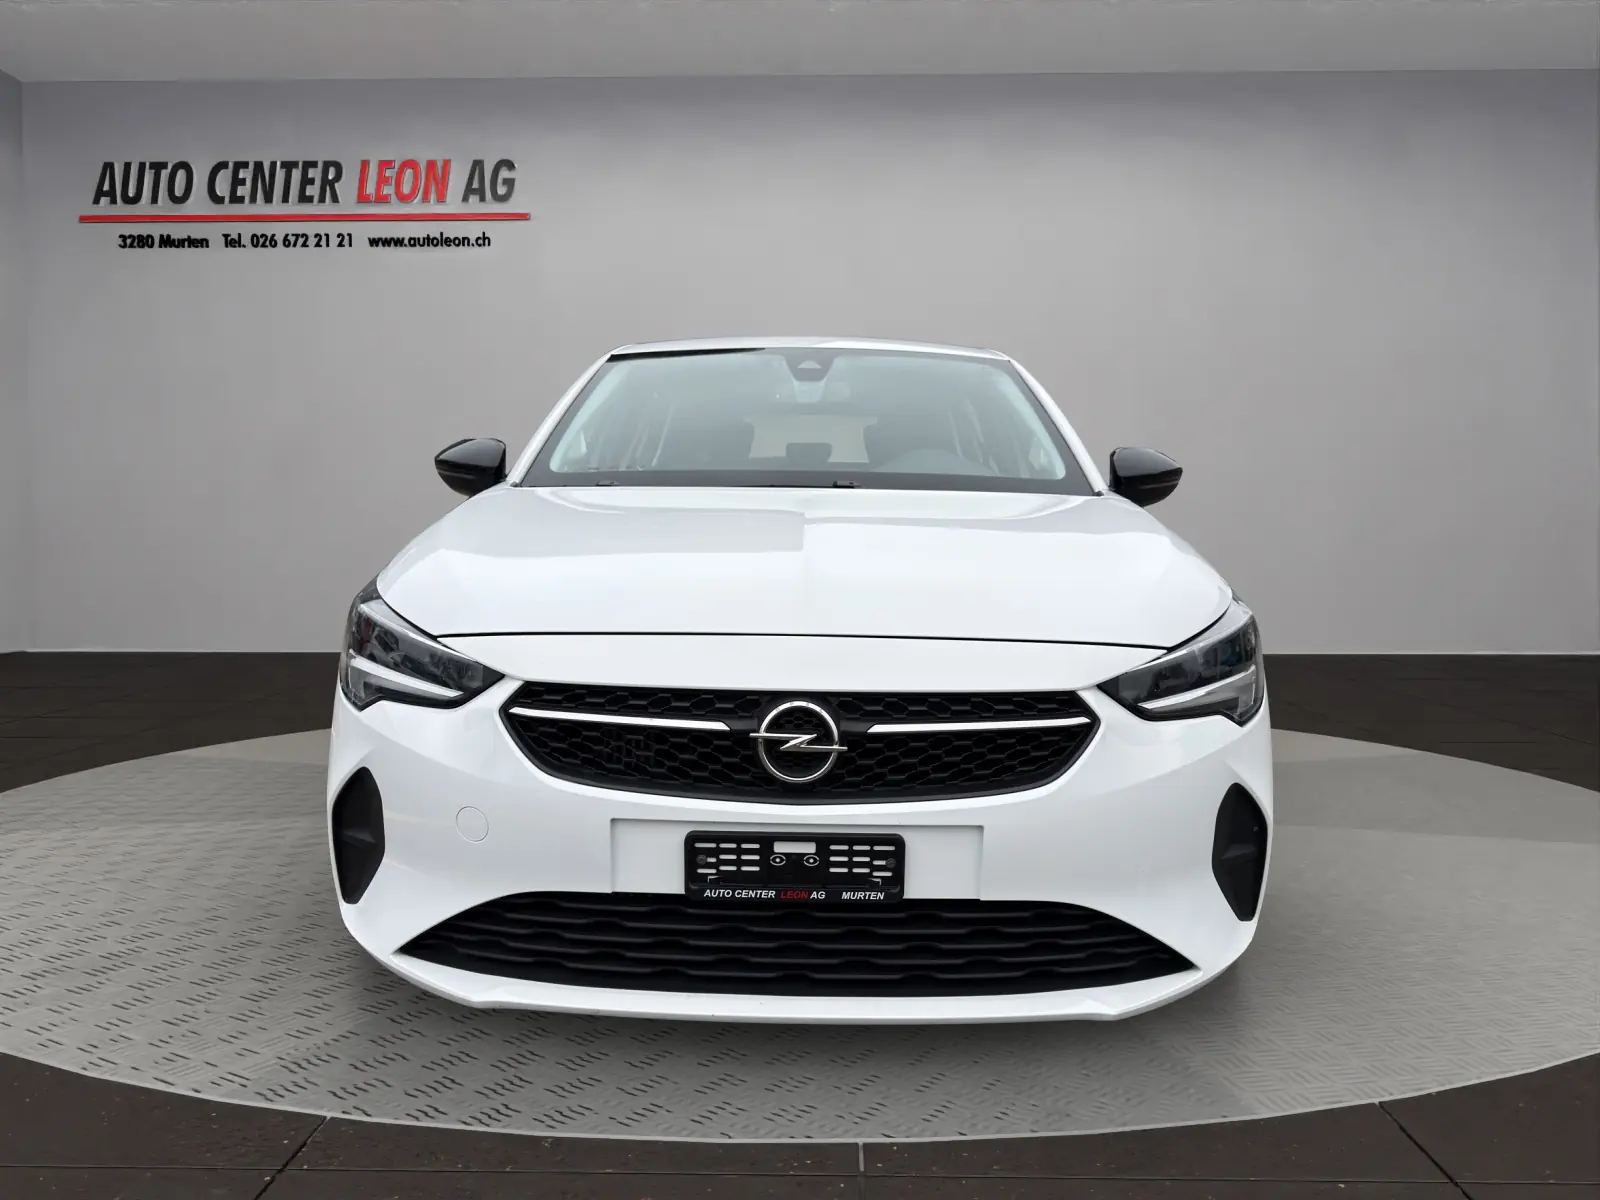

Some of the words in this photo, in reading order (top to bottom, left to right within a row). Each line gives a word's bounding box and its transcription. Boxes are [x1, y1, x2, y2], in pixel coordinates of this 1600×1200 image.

[92, 160, 194, 206] AUTO
[206, 159, 344, 206] CENTER
[356, 158, 452, 204] LEON
[461, 158, 516, 204] AG
[118, 234, 155, 249] 3280
[158, 234, 210, 249] Murten
[222, 233, 247, 248] Tel.
[250, 233, 279, 249] 026
[282, 233, 310, 248] 672
[313, 233, 330, 248] 21
[336, 233, 353, 248] 21
[367, 232, 491, 248] www.autoleon.ch
[703, 889, 732, 898] AUTO
[734, 889, 776, 899] CENTER
[780, 890, 809, 899] LEON
[810, 891, 826, 900] AG
[841, 891, 885, 900] MURTEN
